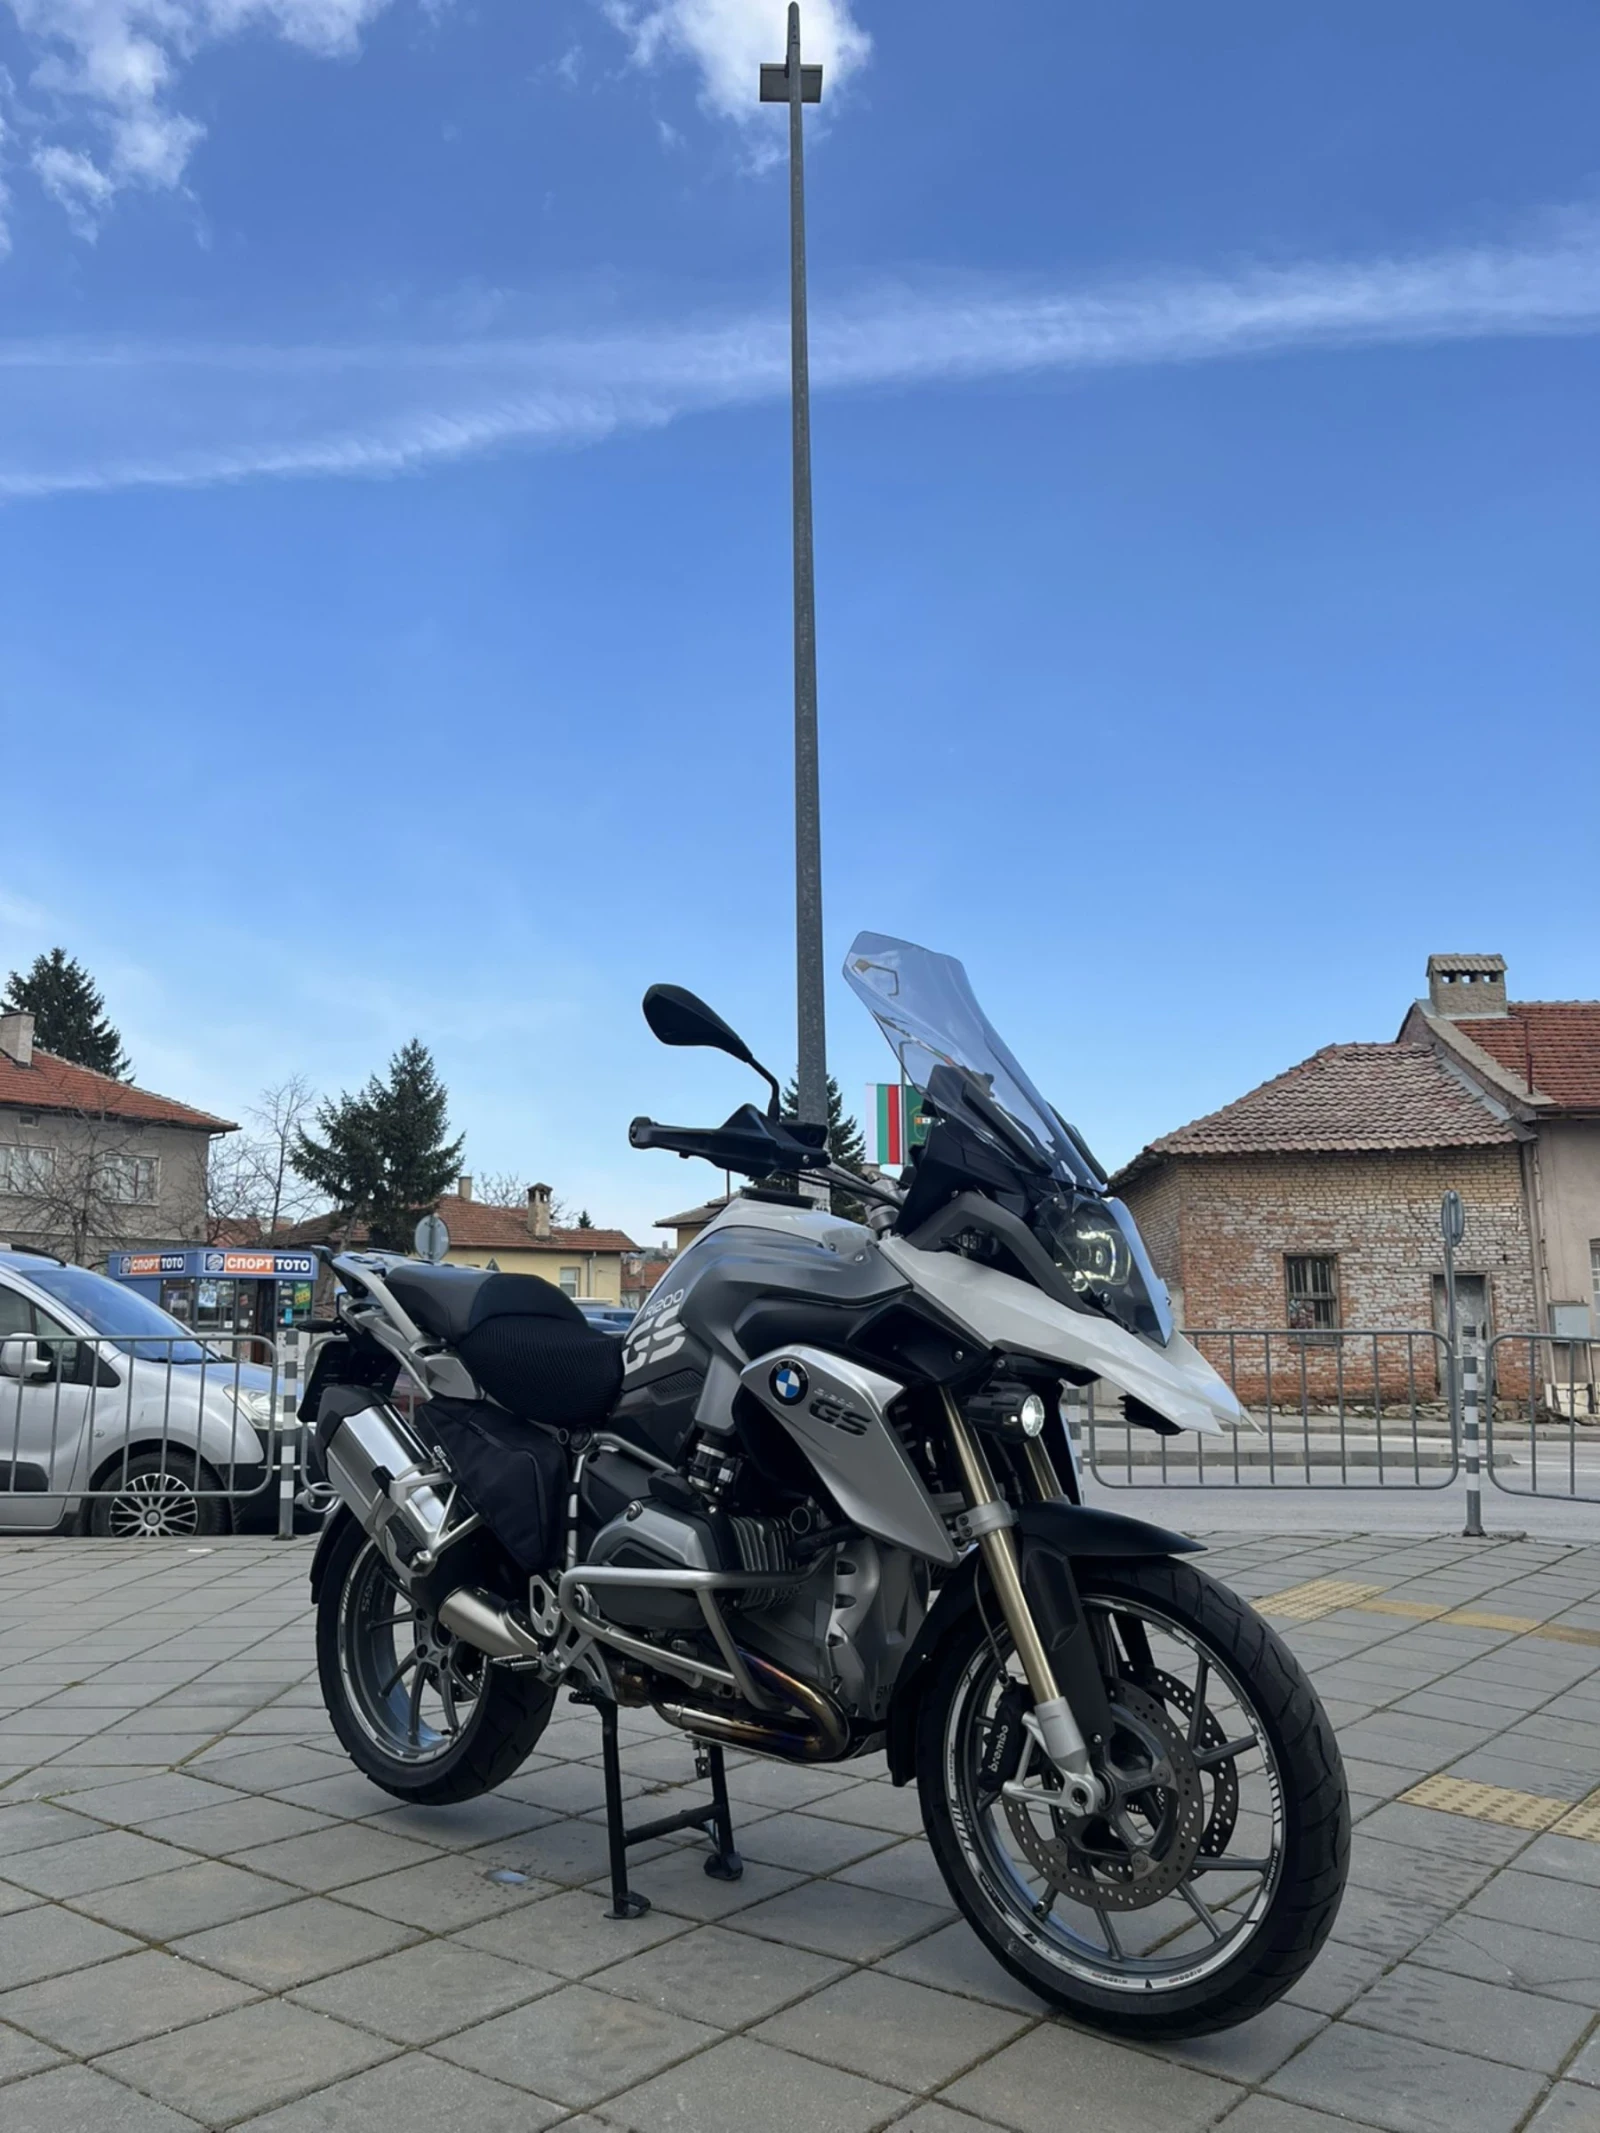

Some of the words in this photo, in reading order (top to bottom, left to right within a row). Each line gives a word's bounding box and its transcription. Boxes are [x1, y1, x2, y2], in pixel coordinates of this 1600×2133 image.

[132, 1256, 159, 1271] СПОРТ
[161, 1256, 183, 1269] ТОТО
[227, 1257, 273, 1270] СПОРТ
[275, 1258, 310, 1271] ТОТО
[622, 1303, 686, 1376] GS
[809, 1398, 872, 1436] GS
[987, 1725, 1009, 1773] brembo
